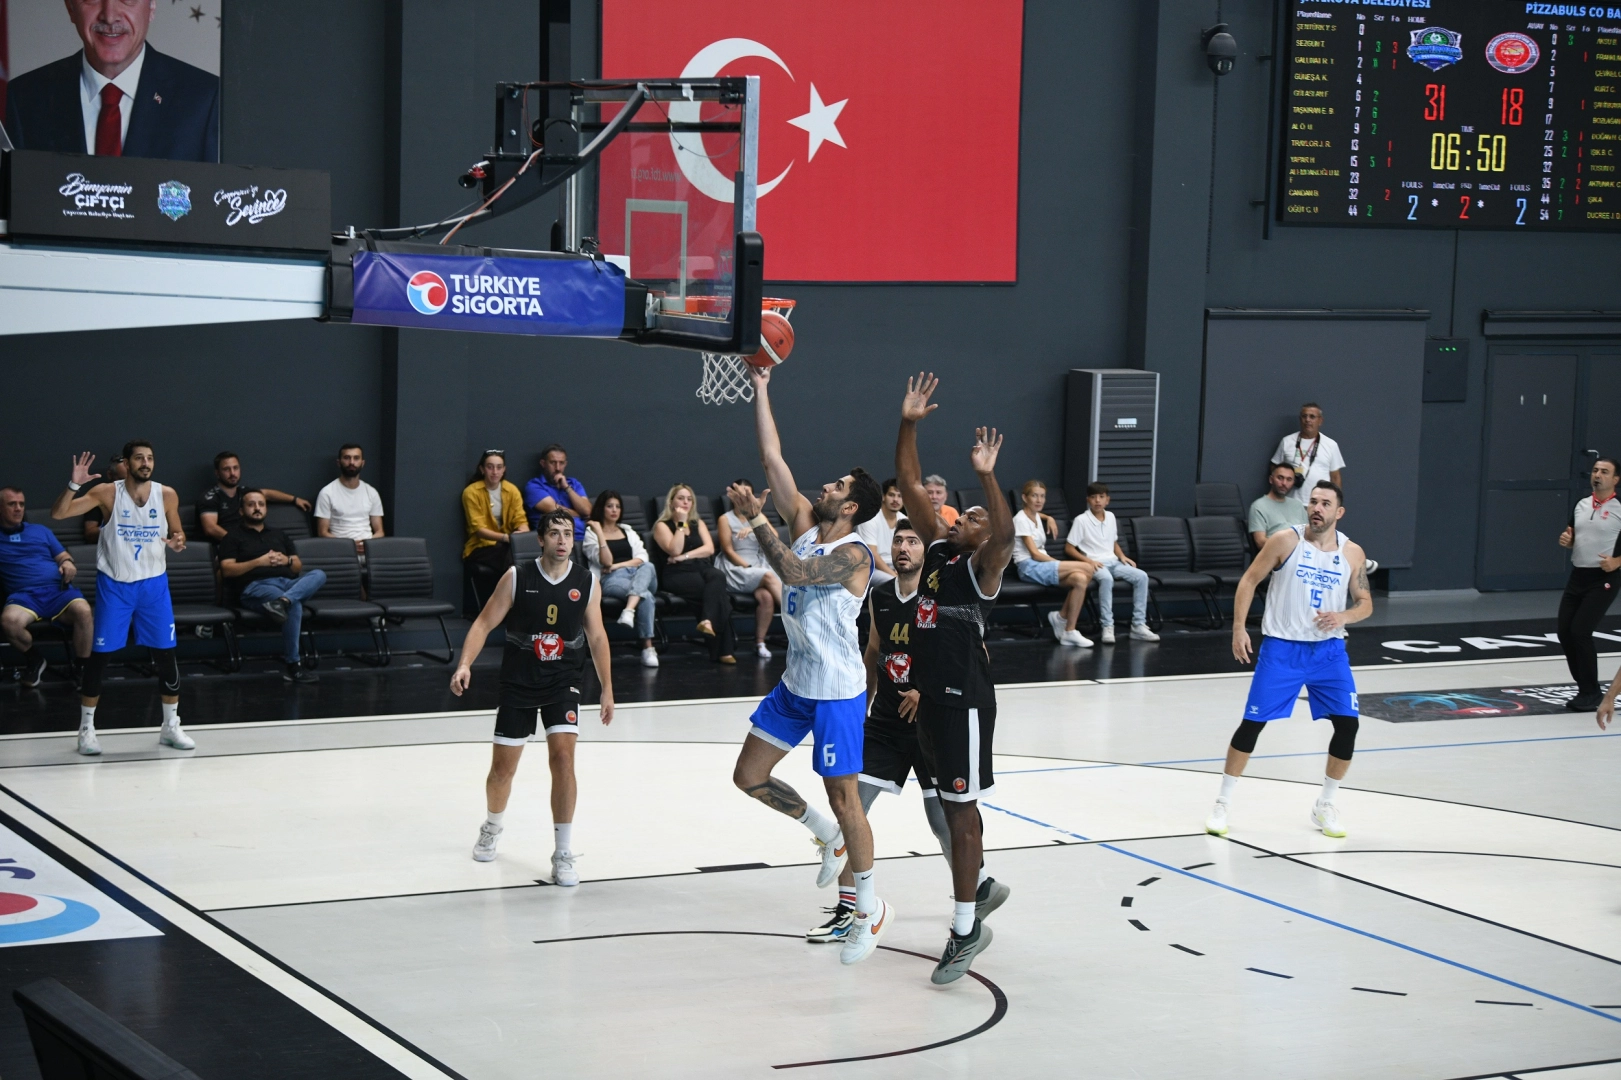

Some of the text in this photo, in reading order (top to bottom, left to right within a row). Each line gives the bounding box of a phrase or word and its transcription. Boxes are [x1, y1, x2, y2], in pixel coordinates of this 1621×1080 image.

[1526, 2, 1586, 17] PİZZABULS
[1589, 7, 1604, 18] CO
[1358, 23, 1365, 36] 0
[1357, 39, 1362, 52] 1
[1375, 41, 1381, 53] 3
[1392, 41, 1398, 53] 3
[1551, 33, 1558, 45] 0
[1568, 34, 1574, 46] 3
[1550, 49, 1557, 61] 2
[1584, 51, 1588, 63] 1
[1357, 56, 1363, 69] 2
[1393, 58, 1397, 70] 1
[1550, 65, 1556, 77] 5
[1356, 73, 1362, 85] 4
[1549, 81, 1555, 93] 7
[1355, 89, 1361, 102] 6
[1373, 90, 1379, 102] 2
[1424, 83, 1446, 121] 31
[1501, 87, 1524, 126] 18
[1548, 97, 1554, 109] 9
[1581, 99, 1585, 110] 1
[1355, 106, 1360, 118] 7
[1545, 113, 1553, 125] 17
[1354, 122, 1360, 135] 9
[1371, 123, 1377, 135] 2
[1461, 125, 1475, 133] TIME
[1544, 129, 1554, 141] 22
[1562, 130, 1568, 142] 3
[1579, 131, 1583, 142] 1
[1351, 139, 1359, 151] 13
[1388, 140, 1392, 151] 1
[1543, 145, 1553, 157] 25
[1561, 146, 1567, 158] 2
[1578, 146, 1582, 158] 1
[1430, 132, 1507, 172] 06:50
[1350, 155, 1358, 168] 15
[1369, 155, 1375, 168] 5
[1387, 157, 1391, 168] 1
[1543, 161, 1552, 173] 32
[1577, 162, 1581, 174] 1
[1350, 171, 1359, 184] 23
[1541, 177, 1551, 189] 35
[1560, 177, 1566, 189] 2
[1575, 178, 1581, 190] 2
[59, 173, 133, 197] Bünyamin
[1401, 181, 1423, 189] FOULS
[1432, 182, 1455, 190] TimeOut
[1478, 183, 1501, 191] TimeOut
[1510, 183, 1531, 191] FOULS
[1348, 188, 1359, 200] 32
[1384, 189, 1390, 201] 2
[1540, 193, 1550, 205] 44
[1575, 194, 1579, 205] 1
[226, 189, 287, 226] Sevince
[1348, 204, 1357, 217] 44
[1367, 204, 1373, 217] 2
[1407, 195, 1418, 220] 2
[1459, 196, 1471, 219] 2
[1515, 198, 1527, 225] 2
[1540, 208, 1550, 221] 54
[134, 544, 142, 561] 7
[788, 591, 798, 616] 6
[1310, 588, 1323, 609] 15
[546, 604, 558, 625] 9
[169, 623, 176, 641] 7
[531, 632, 559, 641] pizza
[890, 622, 909, 645] 44
[541, 653, 563, 661] bulls
[885, 653, 908, 662] pizza
[823, 743, 837, 767] 6
